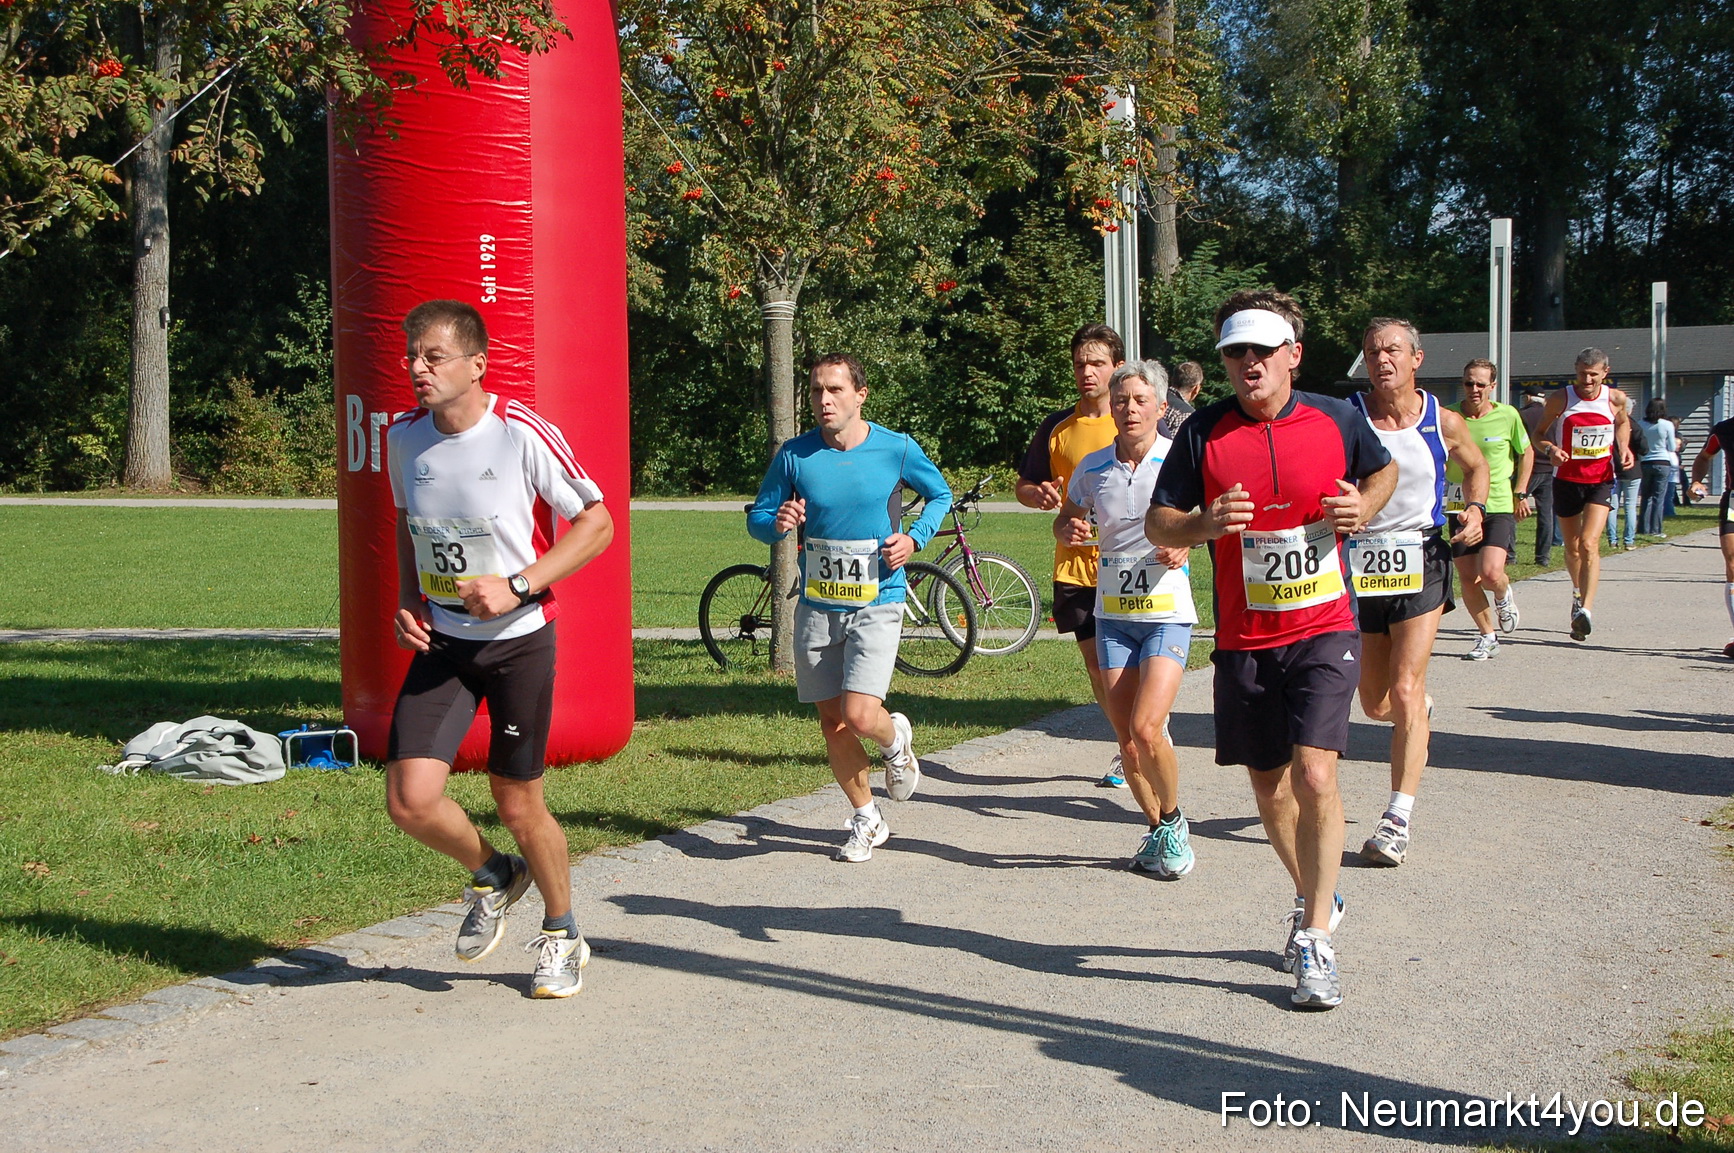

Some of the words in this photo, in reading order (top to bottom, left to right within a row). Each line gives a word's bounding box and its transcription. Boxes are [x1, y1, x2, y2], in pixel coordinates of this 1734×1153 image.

[479, 233, 497, 270] 1929
[480, 275, 497, 303] Seit
[346, 394, 405, 472] Br
[1581, 434, 1605, 447] 677
[1255, 535, 1298, 545] PFLEIDERER
[431, 542, 467, 574] 53
[819, 556, 862, 581] 314
[1264, 545, 1320, 581] 208
[1362, 549, 1407, 573] 289
[820, 582, 862, 597] Roland
[1119, 569, 1149, 594] 24
[1271, 581, 1318, 600] Xaver
[1360, 575, 1410, 588] Gerhard
[1119, 597, 1153, 610] Petra
